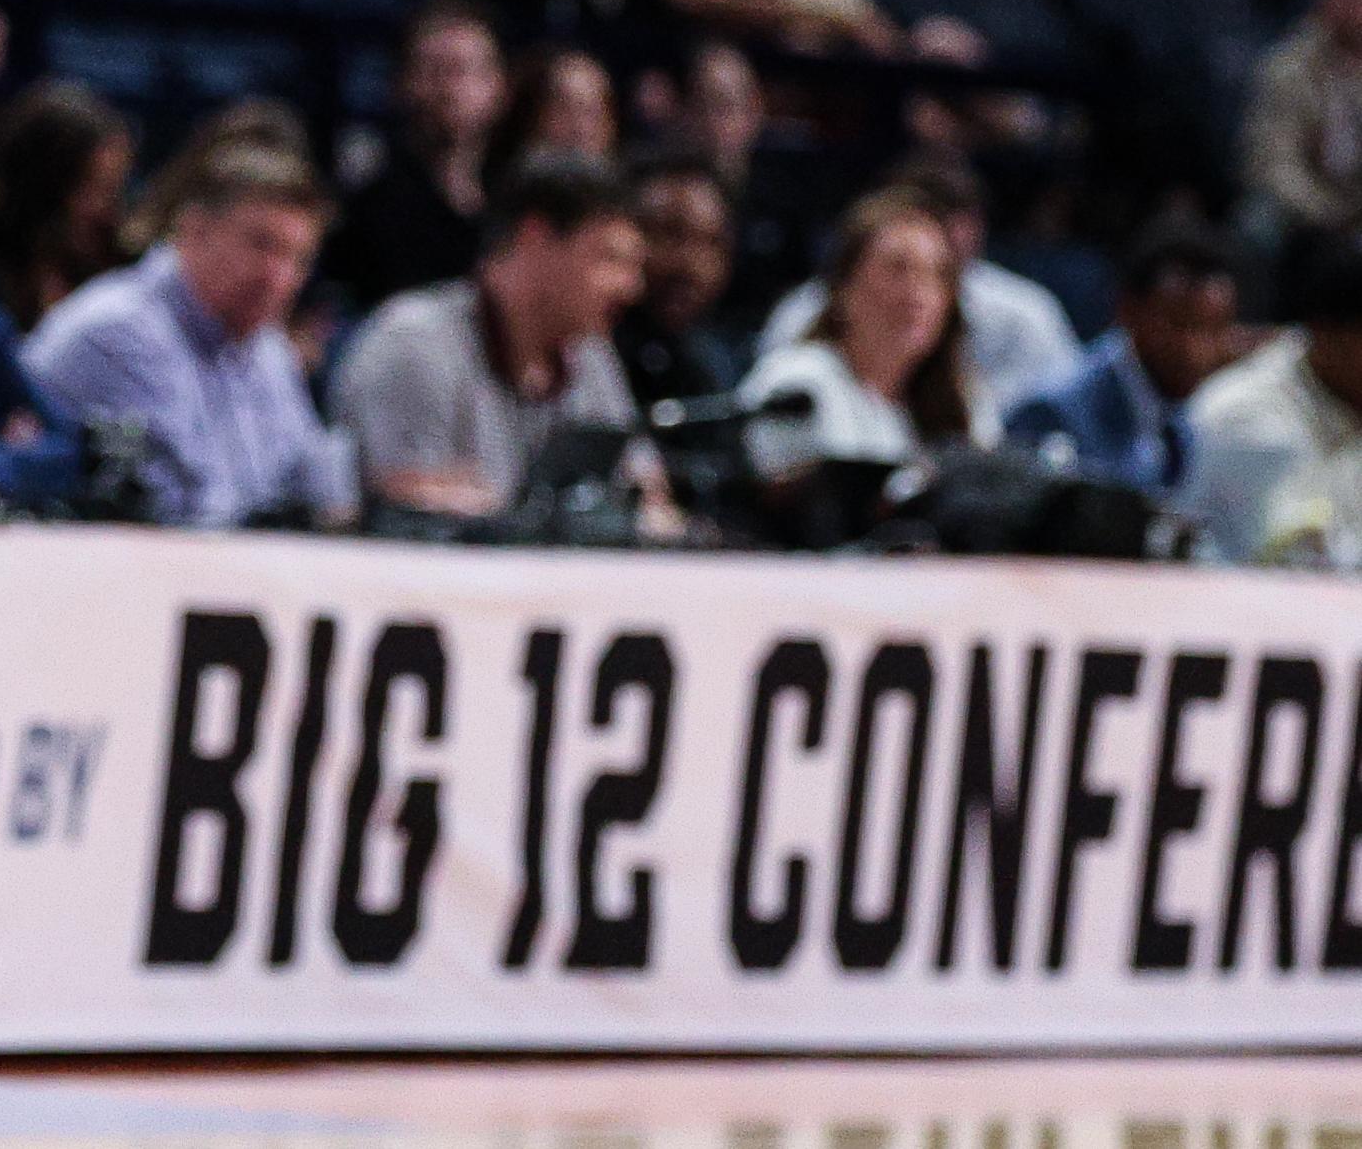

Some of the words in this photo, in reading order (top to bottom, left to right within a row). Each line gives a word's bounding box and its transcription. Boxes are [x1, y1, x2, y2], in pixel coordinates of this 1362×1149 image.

[8, 720, 109, 844] BY
[143, 608, 447, 966] BIG
[502, 628, 675, 971] 12
